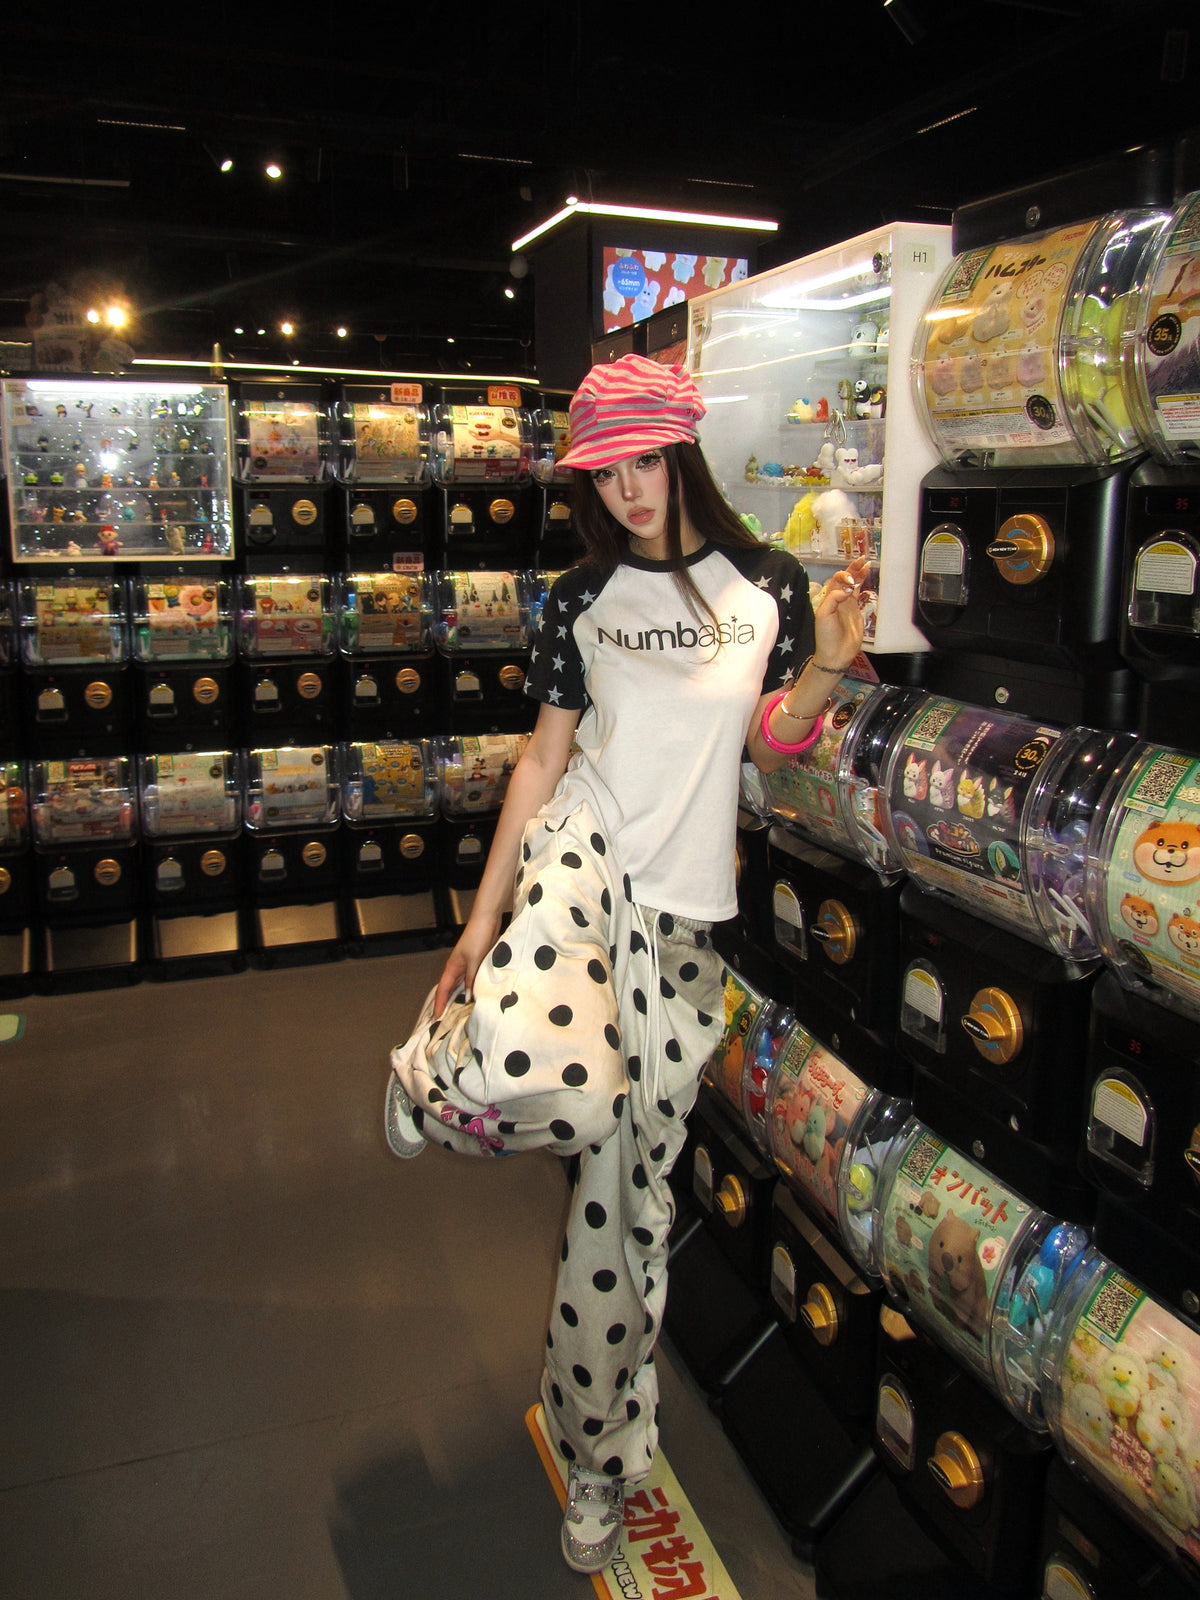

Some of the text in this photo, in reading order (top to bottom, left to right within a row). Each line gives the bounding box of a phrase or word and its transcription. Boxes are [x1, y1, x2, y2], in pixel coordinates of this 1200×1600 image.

[912, 251, 927, 264] H1
[597, 615, 755, 651] Numbasia
[930, 1165, 1008, 1225] オンバット
[622, 1486, 720, 1600] 动物
